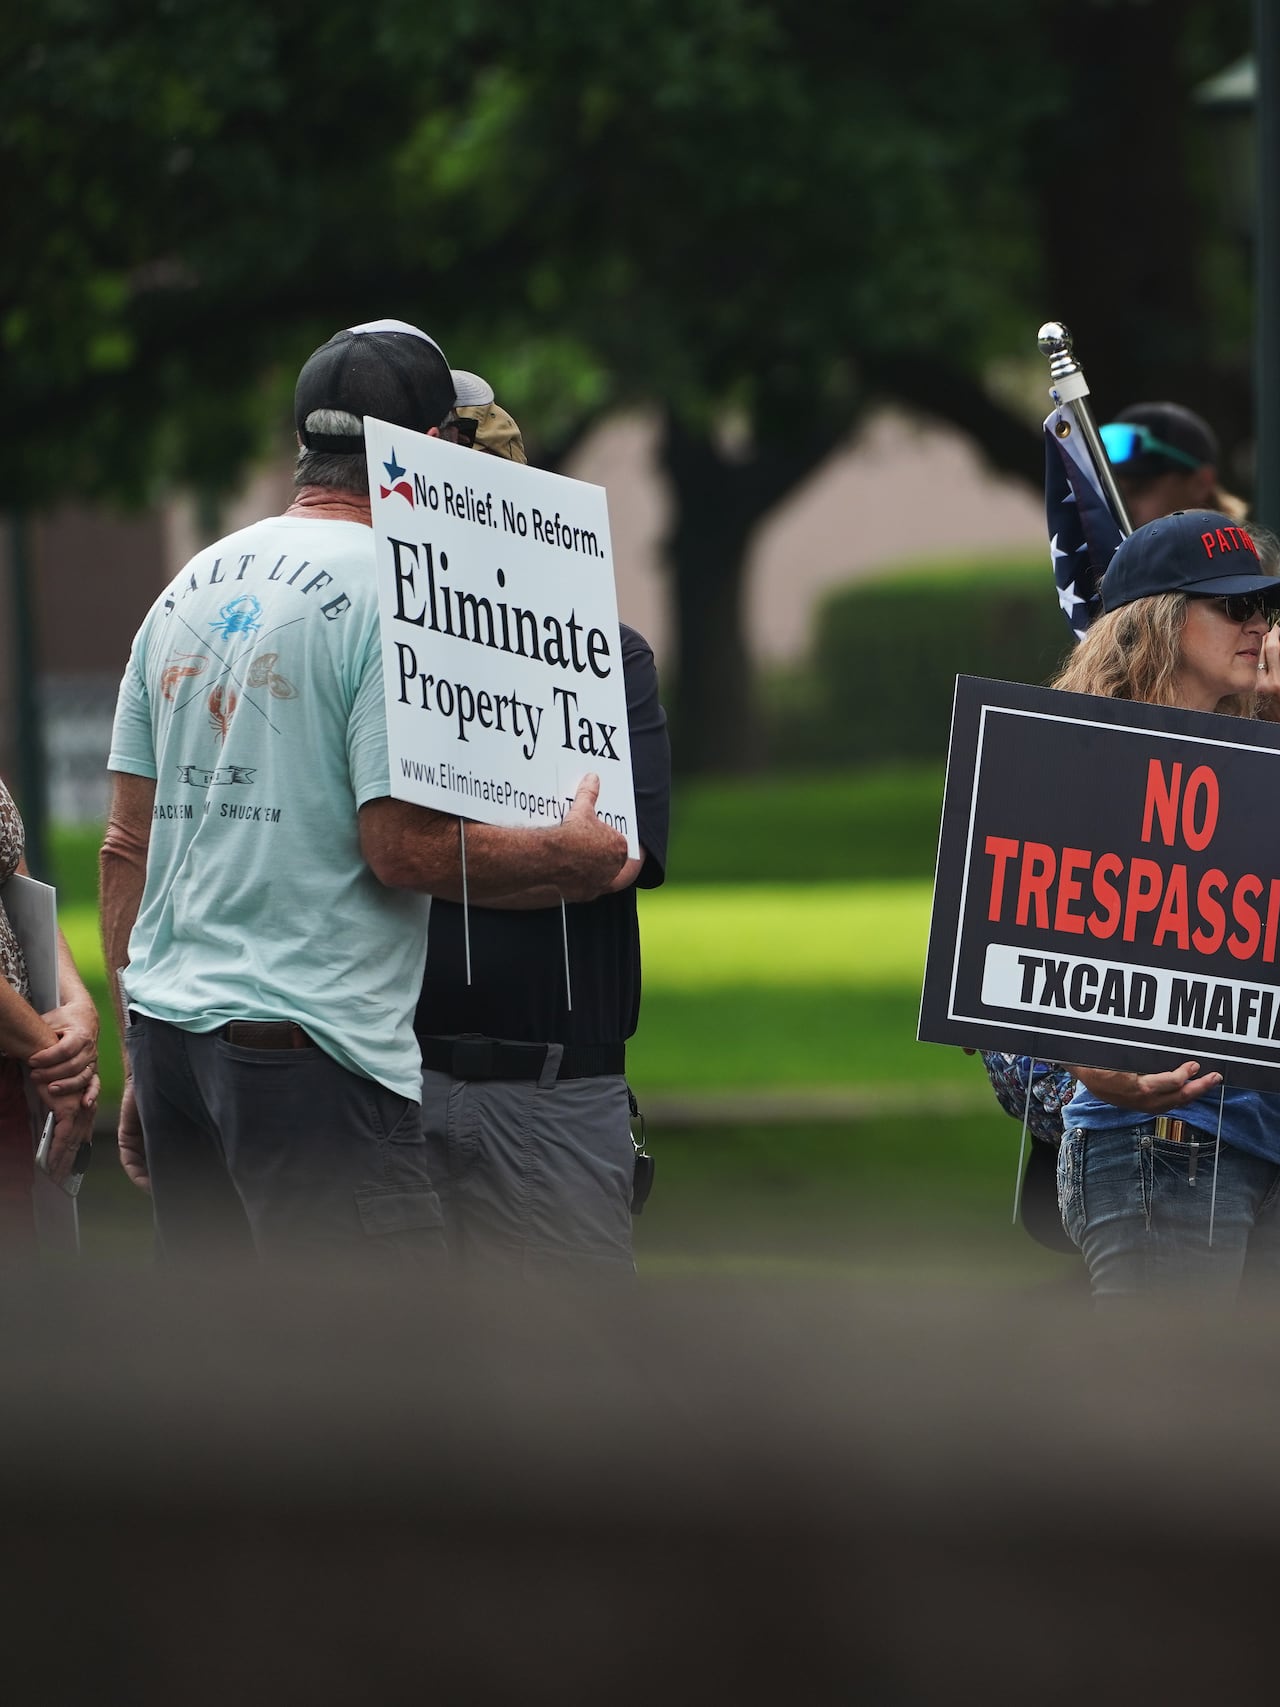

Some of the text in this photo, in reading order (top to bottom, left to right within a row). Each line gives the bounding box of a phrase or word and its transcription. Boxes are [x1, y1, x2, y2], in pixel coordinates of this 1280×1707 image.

[413, 472, 605, 558] No Relief. No Reform.
[267, 554, 352, 622] LIFE
[386, 536, 611, 679] Eliminate
[394, 641, 620, 761] Property Tax
[220, 803, 262, 821] SHUCK
[1140, 758, 1220, 852] NO
[1017, 954, 1158, 1021] TXCAD
